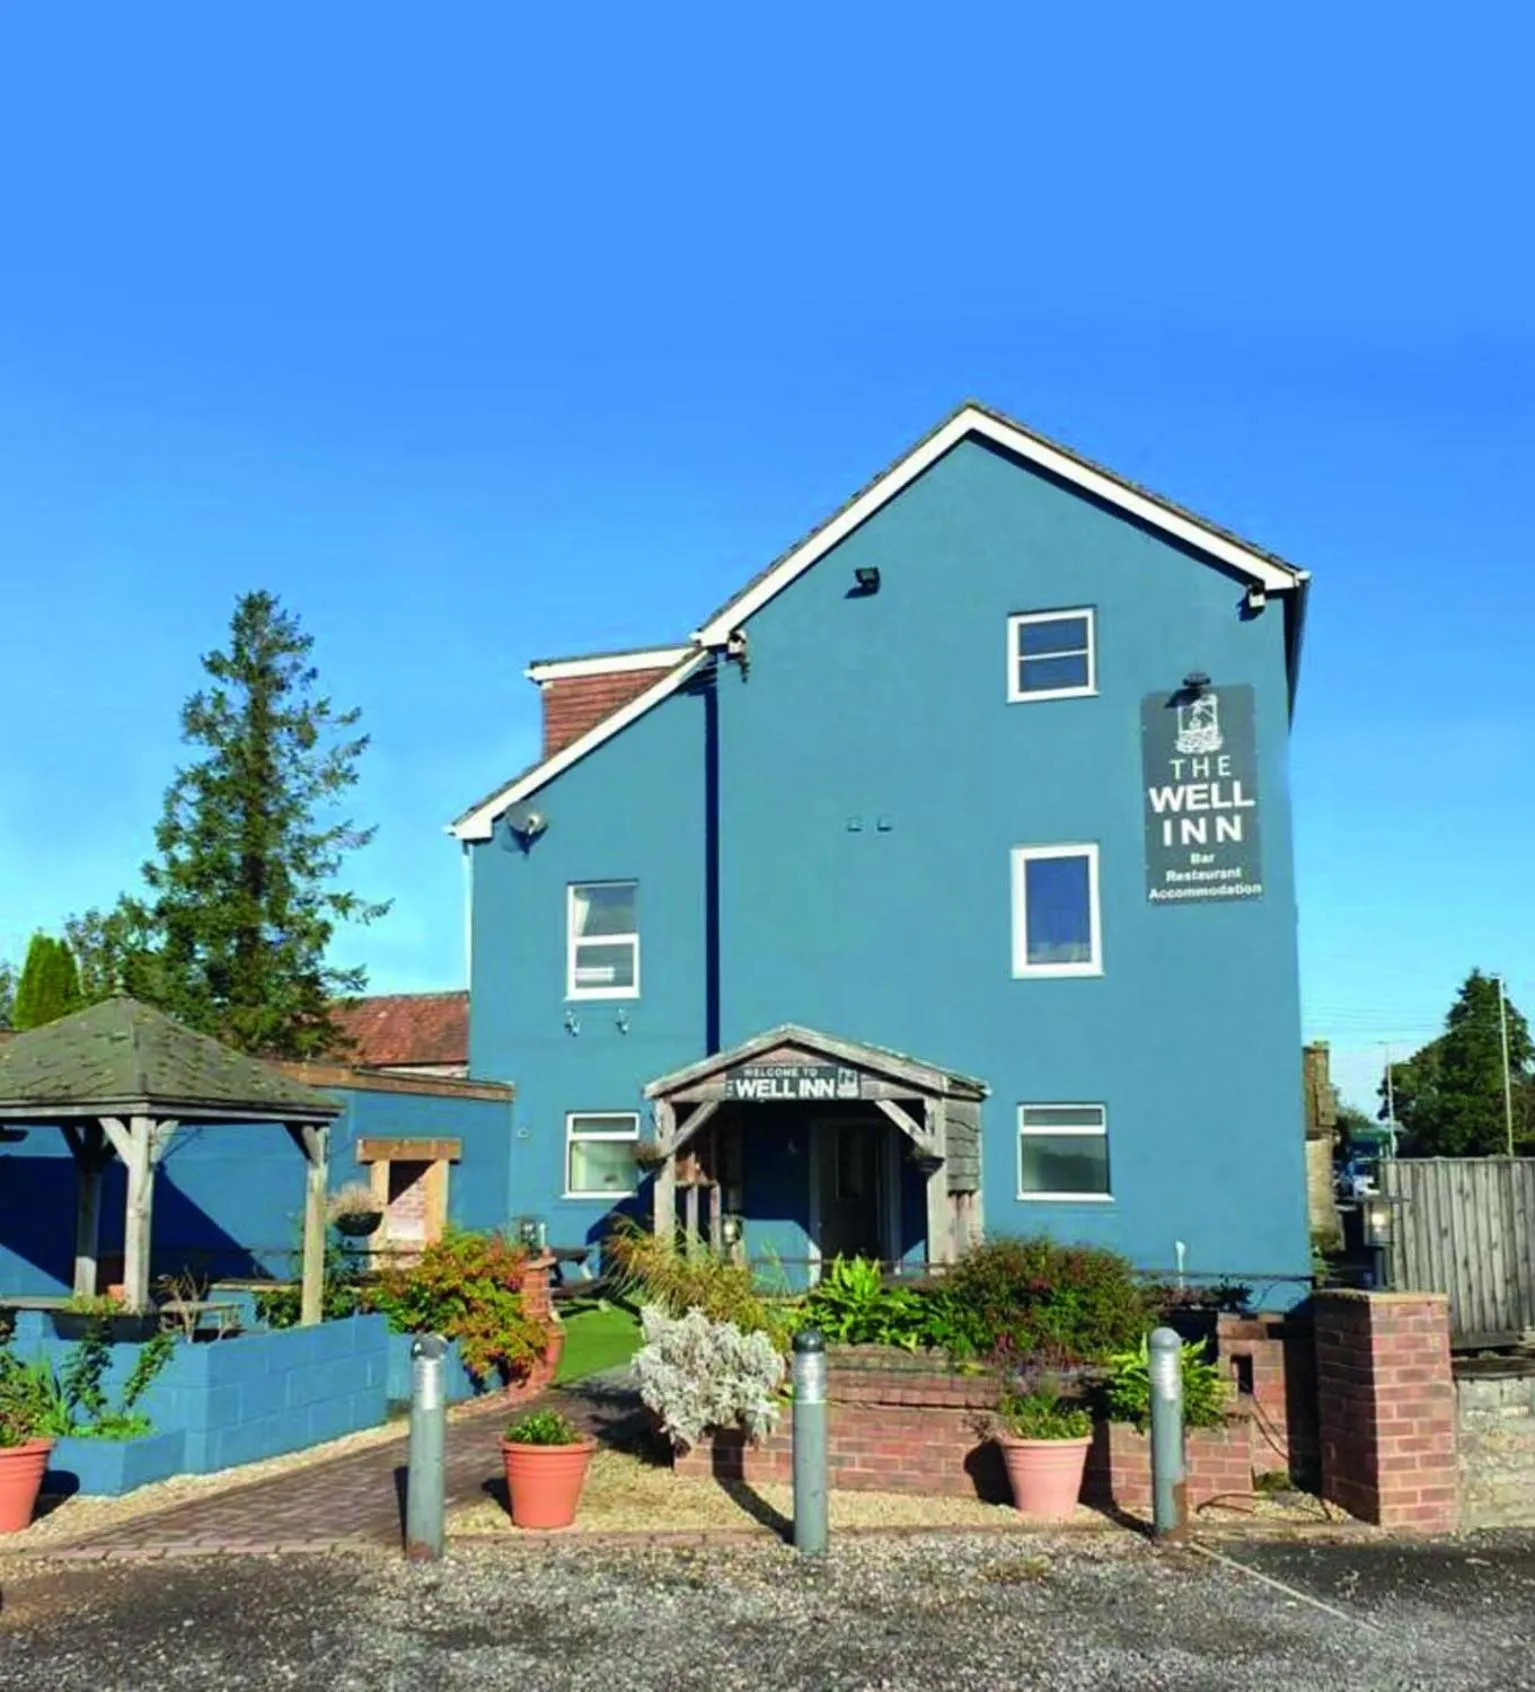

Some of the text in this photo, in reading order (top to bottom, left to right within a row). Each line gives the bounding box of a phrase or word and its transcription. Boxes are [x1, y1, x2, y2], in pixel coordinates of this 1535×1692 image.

[1169, 755, 1232, 780] THE
[1149, 780, 1255, 813] WELL
[1163, 815, 1242, 846] INN
[1190, 852, 1215, 865] Bar
[1166, 867, 1242, 882] Restaurant
[1149, 883, 1262, 900] Accommodation
[744, 1067, 818, 1077] WELCOME TO
[735, 1078, 795, 1099] WELL
[799, 1078, 835, 1099] INN
